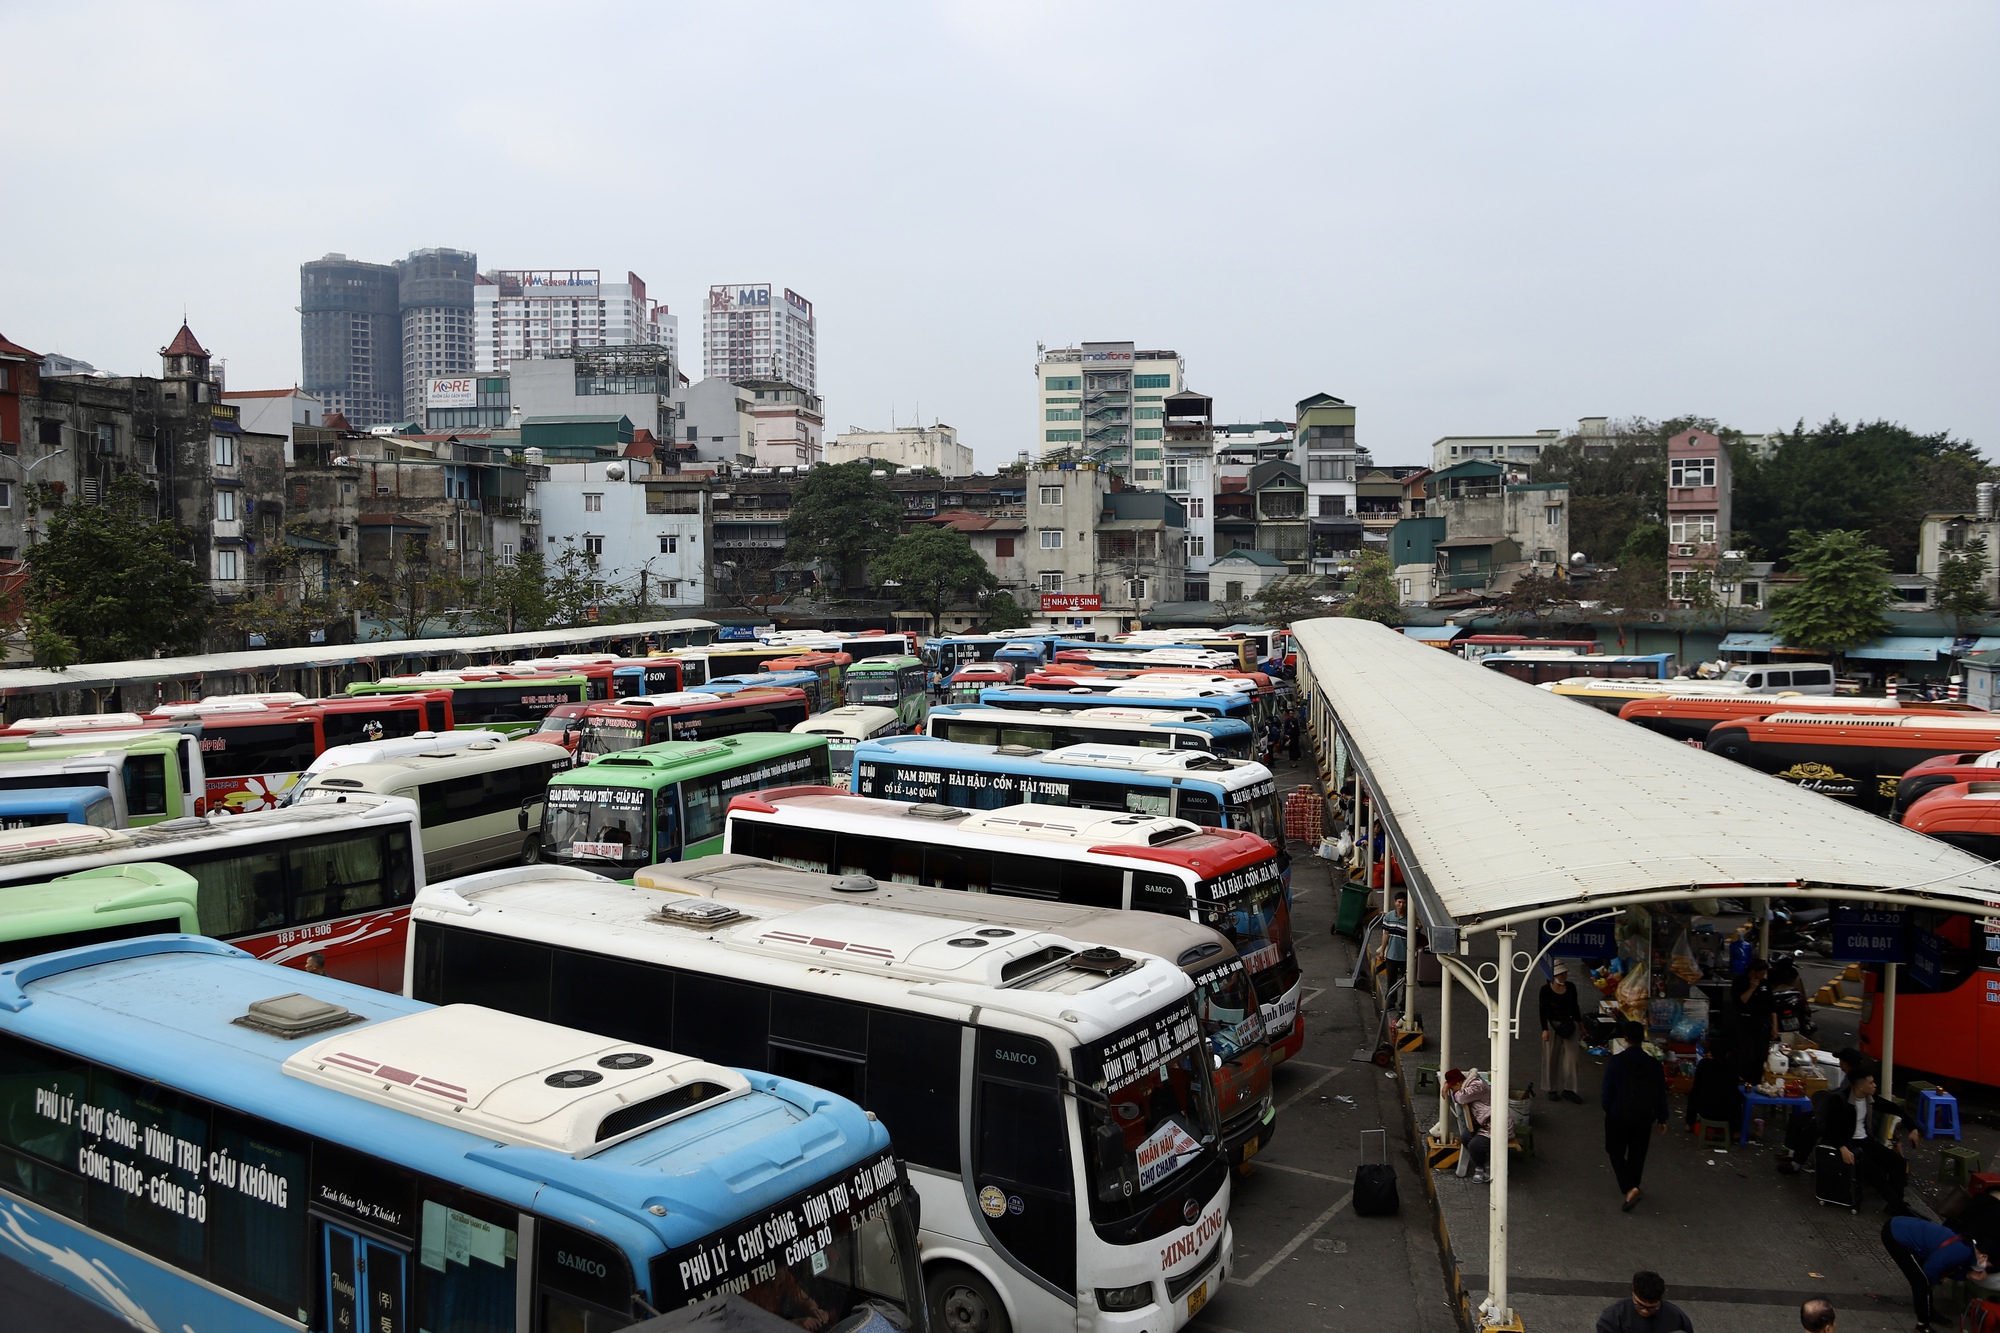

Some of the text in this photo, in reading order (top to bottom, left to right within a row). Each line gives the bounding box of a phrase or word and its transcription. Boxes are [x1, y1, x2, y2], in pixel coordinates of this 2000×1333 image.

[738, 290, 768, 306] MB
[1084, 352, 1130, 360] mobifone
[1052, 596, 1068, 606] NHÀ
[1070, 596, 1079, 606] VỆ
[213, 736, 226, 750] BÁT
[898, 770, 917, 782] NAM
[918, 772, 941, 785] ĐỊNH
[949, 771, 965, 786] HẢI
[967, 773, 987, 789] HẬU
[1020, 777, 1037, 792] HẢI
[1039, 782, 1069, 796] THỊNH
[905, 786, 918, 796] LẠC
[550, 790, 644, 804] GIAO BÁT
[1145, 885, 1173, 894] SAMCO
[1210, 876, 1228, 900] HẢI
[1268, 859, 1280, 880] NỘI
[1862, 914, 1900, 923] A1-20
[1583, 934, 1605, 947] TRỤ
[1847, 933, 1893, 950] CỬA ĐẠT
[1156, 1006, 1190, 1030] B.X GIÁP BÁT
[1104, 1028, 1149, 1056] B.X VĨNH TRỤ
[995, 1049, 1037, 1065] SAMCO
[1102, 1058, 1123, 1082] VĨNH
[1122, 1050, 1137, 1073] TRỤ
[1140, 1038, 1158, 1064] XUÂN
[36, 1083, 288, 1209] PHỦ LÝ CHỢ SÔNG VĨNH TRỤ CẦU KHÔNG
[1160, 1134, 1174, 1156] HẬU
[1140, 1156, 1178, 1186] CHỢ CHANH
[80, 1144, 207, 1224] CỐNG TRÓC CỐNG ĐỎ
[320, 1185, 338, 1202] Kính
[339, 1192, 356, 1208] Chào
[357, 1199, 371, 1216] Quý
[679, 1244, 711, 1290] PHỦ
[711, 1238, 728, 1276] LÝ
[738, 1224, 765, 1262] CHỢ
[764, 1210, 798, 1249] SÔNG
[802, 1195, 831, 1228] VĨNH
[828, 1183, 850, 1214] TRỤ
[872, 1155, 897, 1191] KHÔNG
[850, 1209, 868, 1232] B.X
[868, 1195, 887, 1220] GIÁP
[785, 1220, 833, 1267] CỐNG ĐỎ
[1161, 1208, 1222, 1271] MINH TÙNG
[557, 1250, 606, 1278] SAMCO
[751, 1260, 777, 1285] TRỤ
[339, 1308, 350, 1330] Lộ
